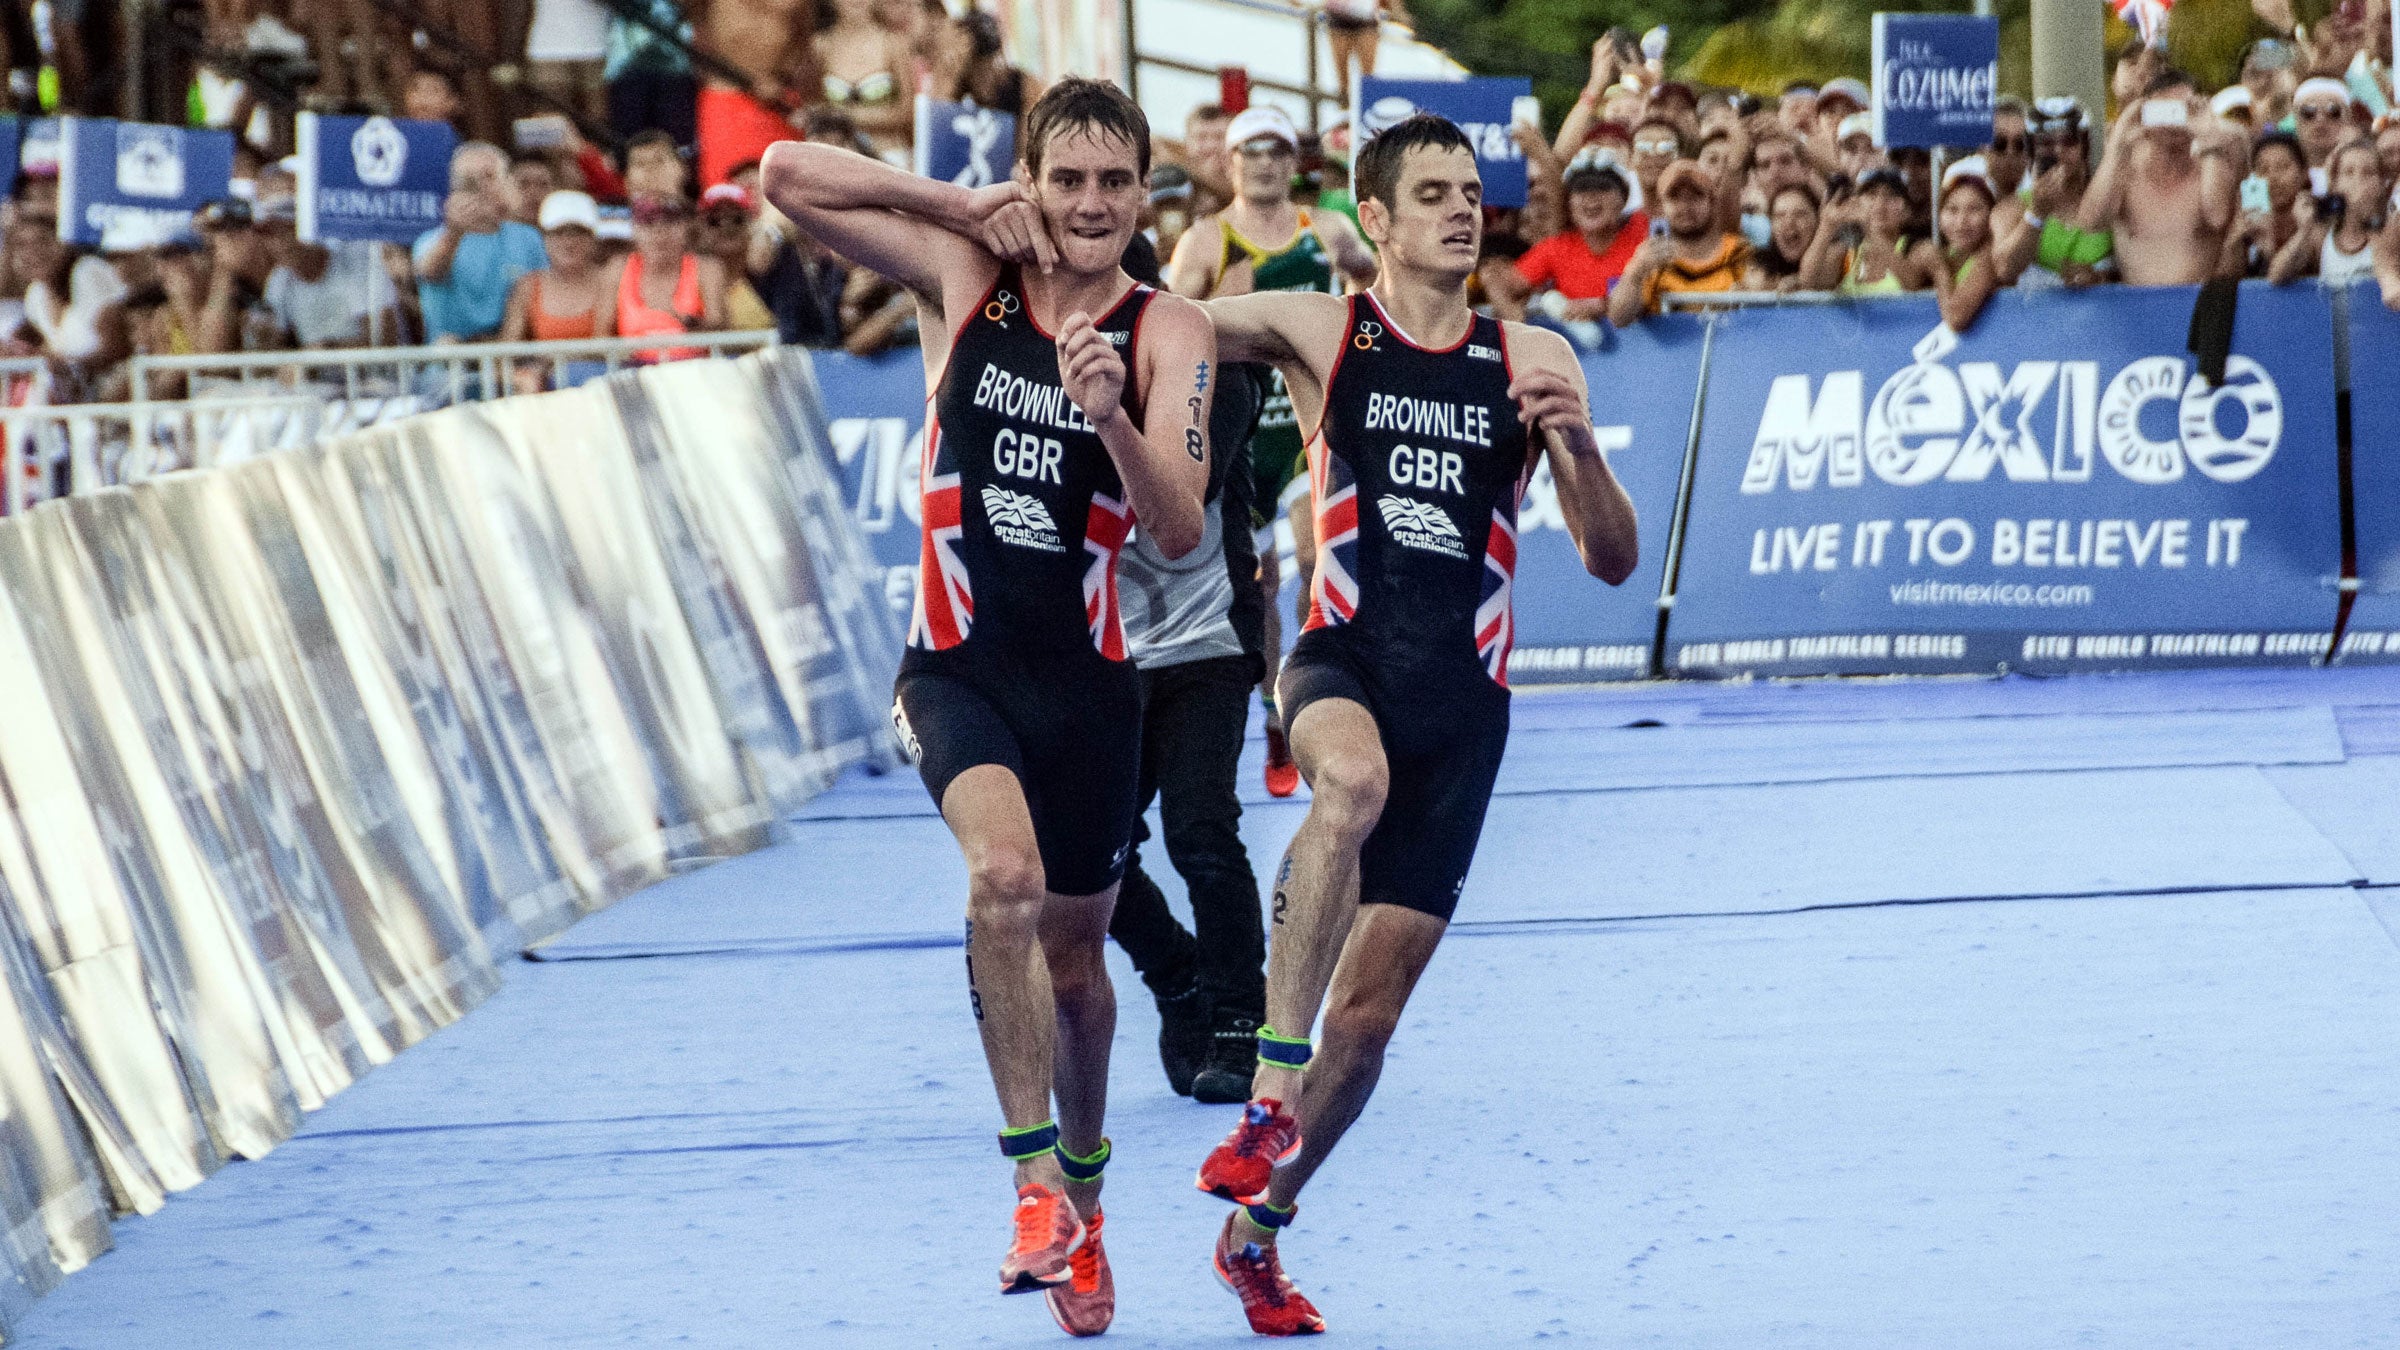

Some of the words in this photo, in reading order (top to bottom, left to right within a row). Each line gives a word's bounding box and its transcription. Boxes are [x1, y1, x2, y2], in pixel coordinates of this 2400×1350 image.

[1365, 391, 1492, 447] BROWNLEE
[993, 428, 1063, 485] GBR
[1388, 444, 1464, 495] GBR
[1749, 526, 1841, 575] LIVE
[1851, 520, 1892, 567] IT
[1904, 517, 1976, 567] TO
[1992, 518, 2191, 568] BELIEVE
[2205, 518, 2249, 568] IT
[1889, 578, 2093, 606] visitmexico.com
[1584, 645, 1647, 667] SERIES
[1723, 639, 1784, 664] WORLD
[1789, 635, 1888, 658] TRIATHLON
[1894, 634, 1966, 658] SERIES
[2076, 635, 2147, 658] WORLD
[2151, 634, 2260, 656] TRIATHLON
[2263, 633, 2336, 655] SERIES
